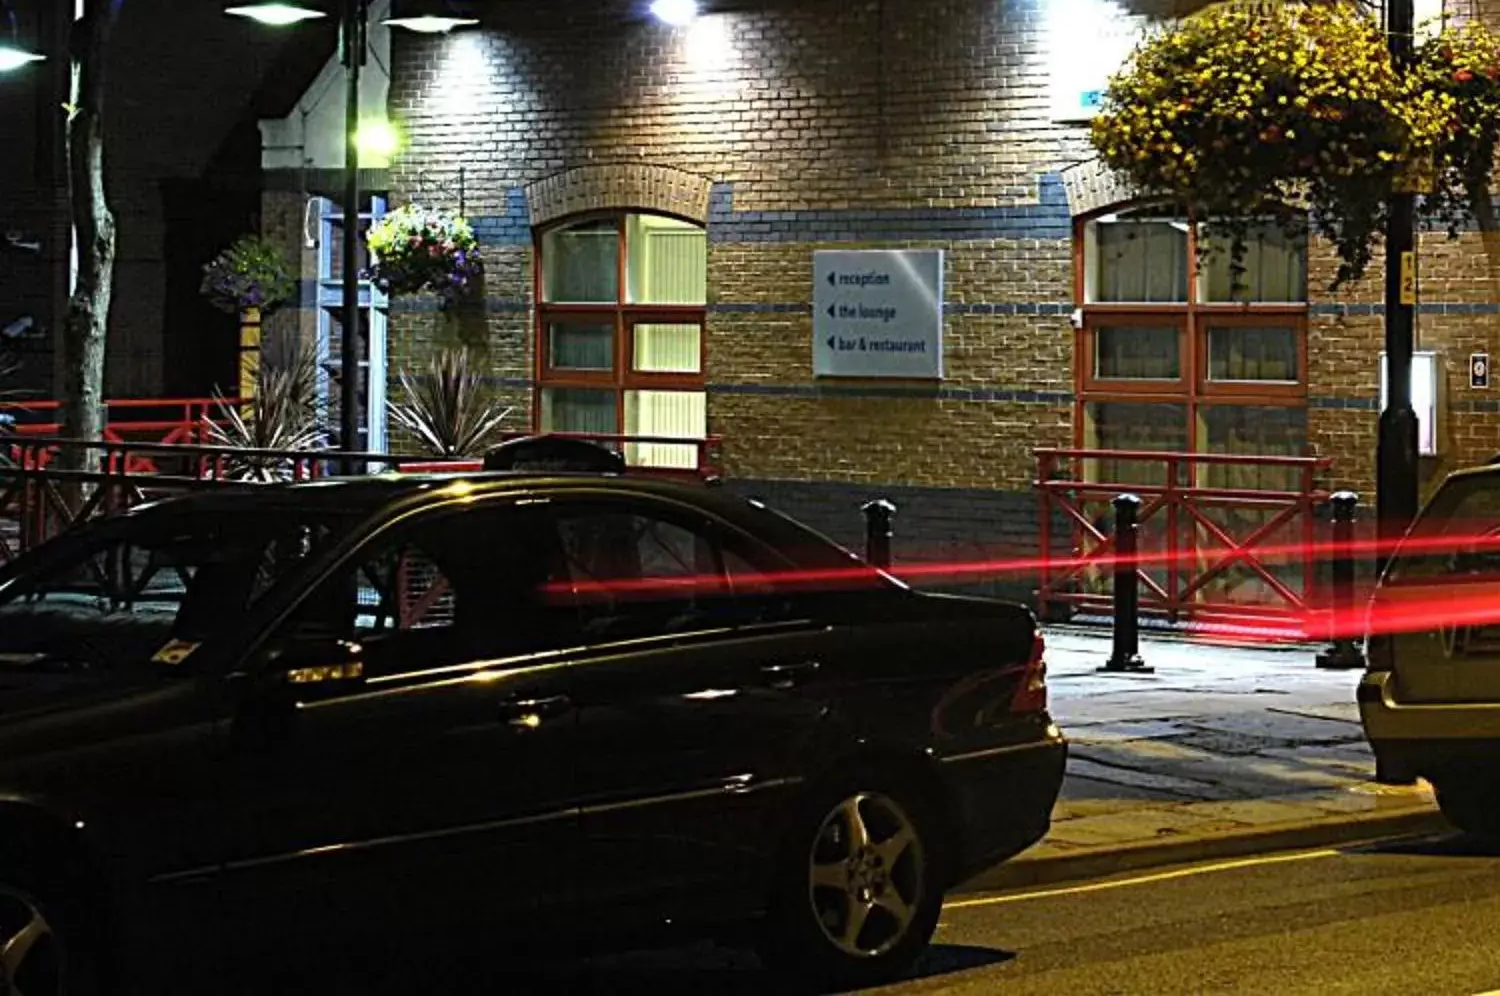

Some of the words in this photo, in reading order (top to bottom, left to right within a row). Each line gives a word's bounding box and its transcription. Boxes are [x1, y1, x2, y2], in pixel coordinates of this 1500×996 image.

[838, 270, 890, 288] reception
[838, 304, 856, 319] the
[859, 304, 896, 323] lounge
[838, 336, 857, 351] bar
[859, 337, 867, 351] &
[869, 338, 926, 352] restaurant
